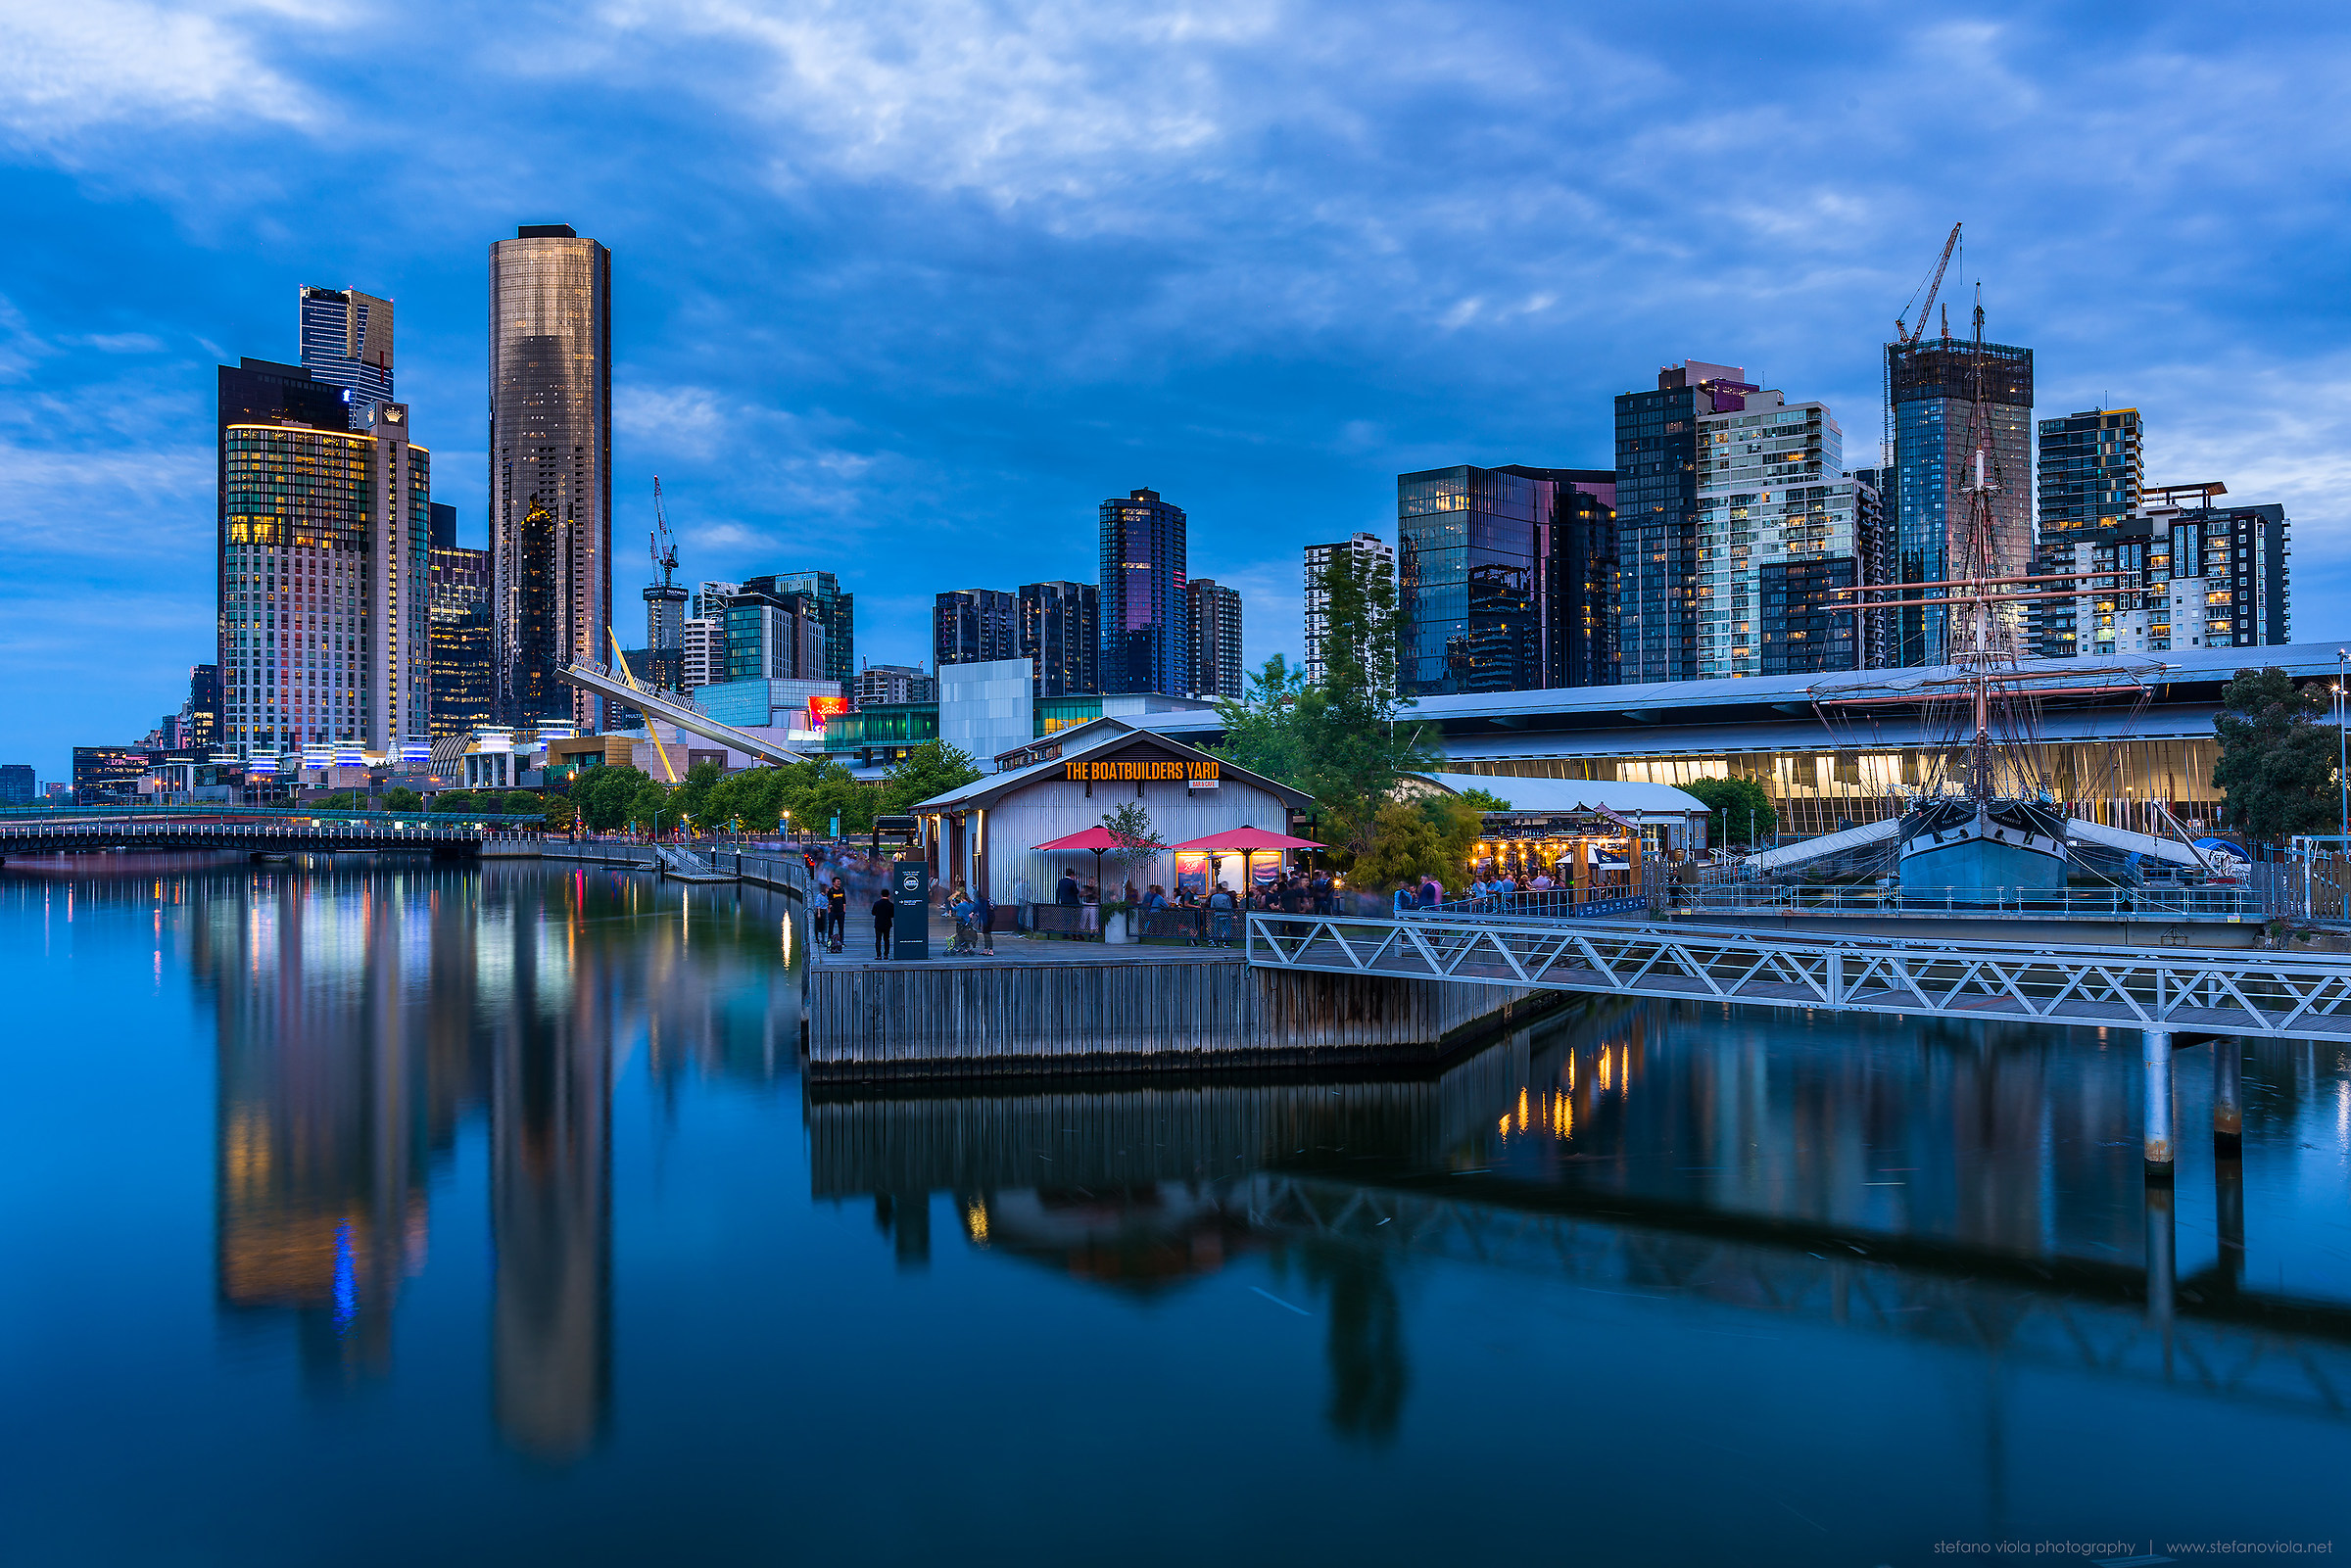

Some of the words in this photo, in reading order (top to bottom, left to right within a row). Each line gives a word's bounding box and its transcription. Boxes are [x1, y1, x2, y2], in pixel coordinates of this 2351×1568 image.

[1065, 762, 1088, 780] THE
[1091, 762, 1183, 780] BOATBUILDERS
[1186, 762, 1220, 780] YARD
